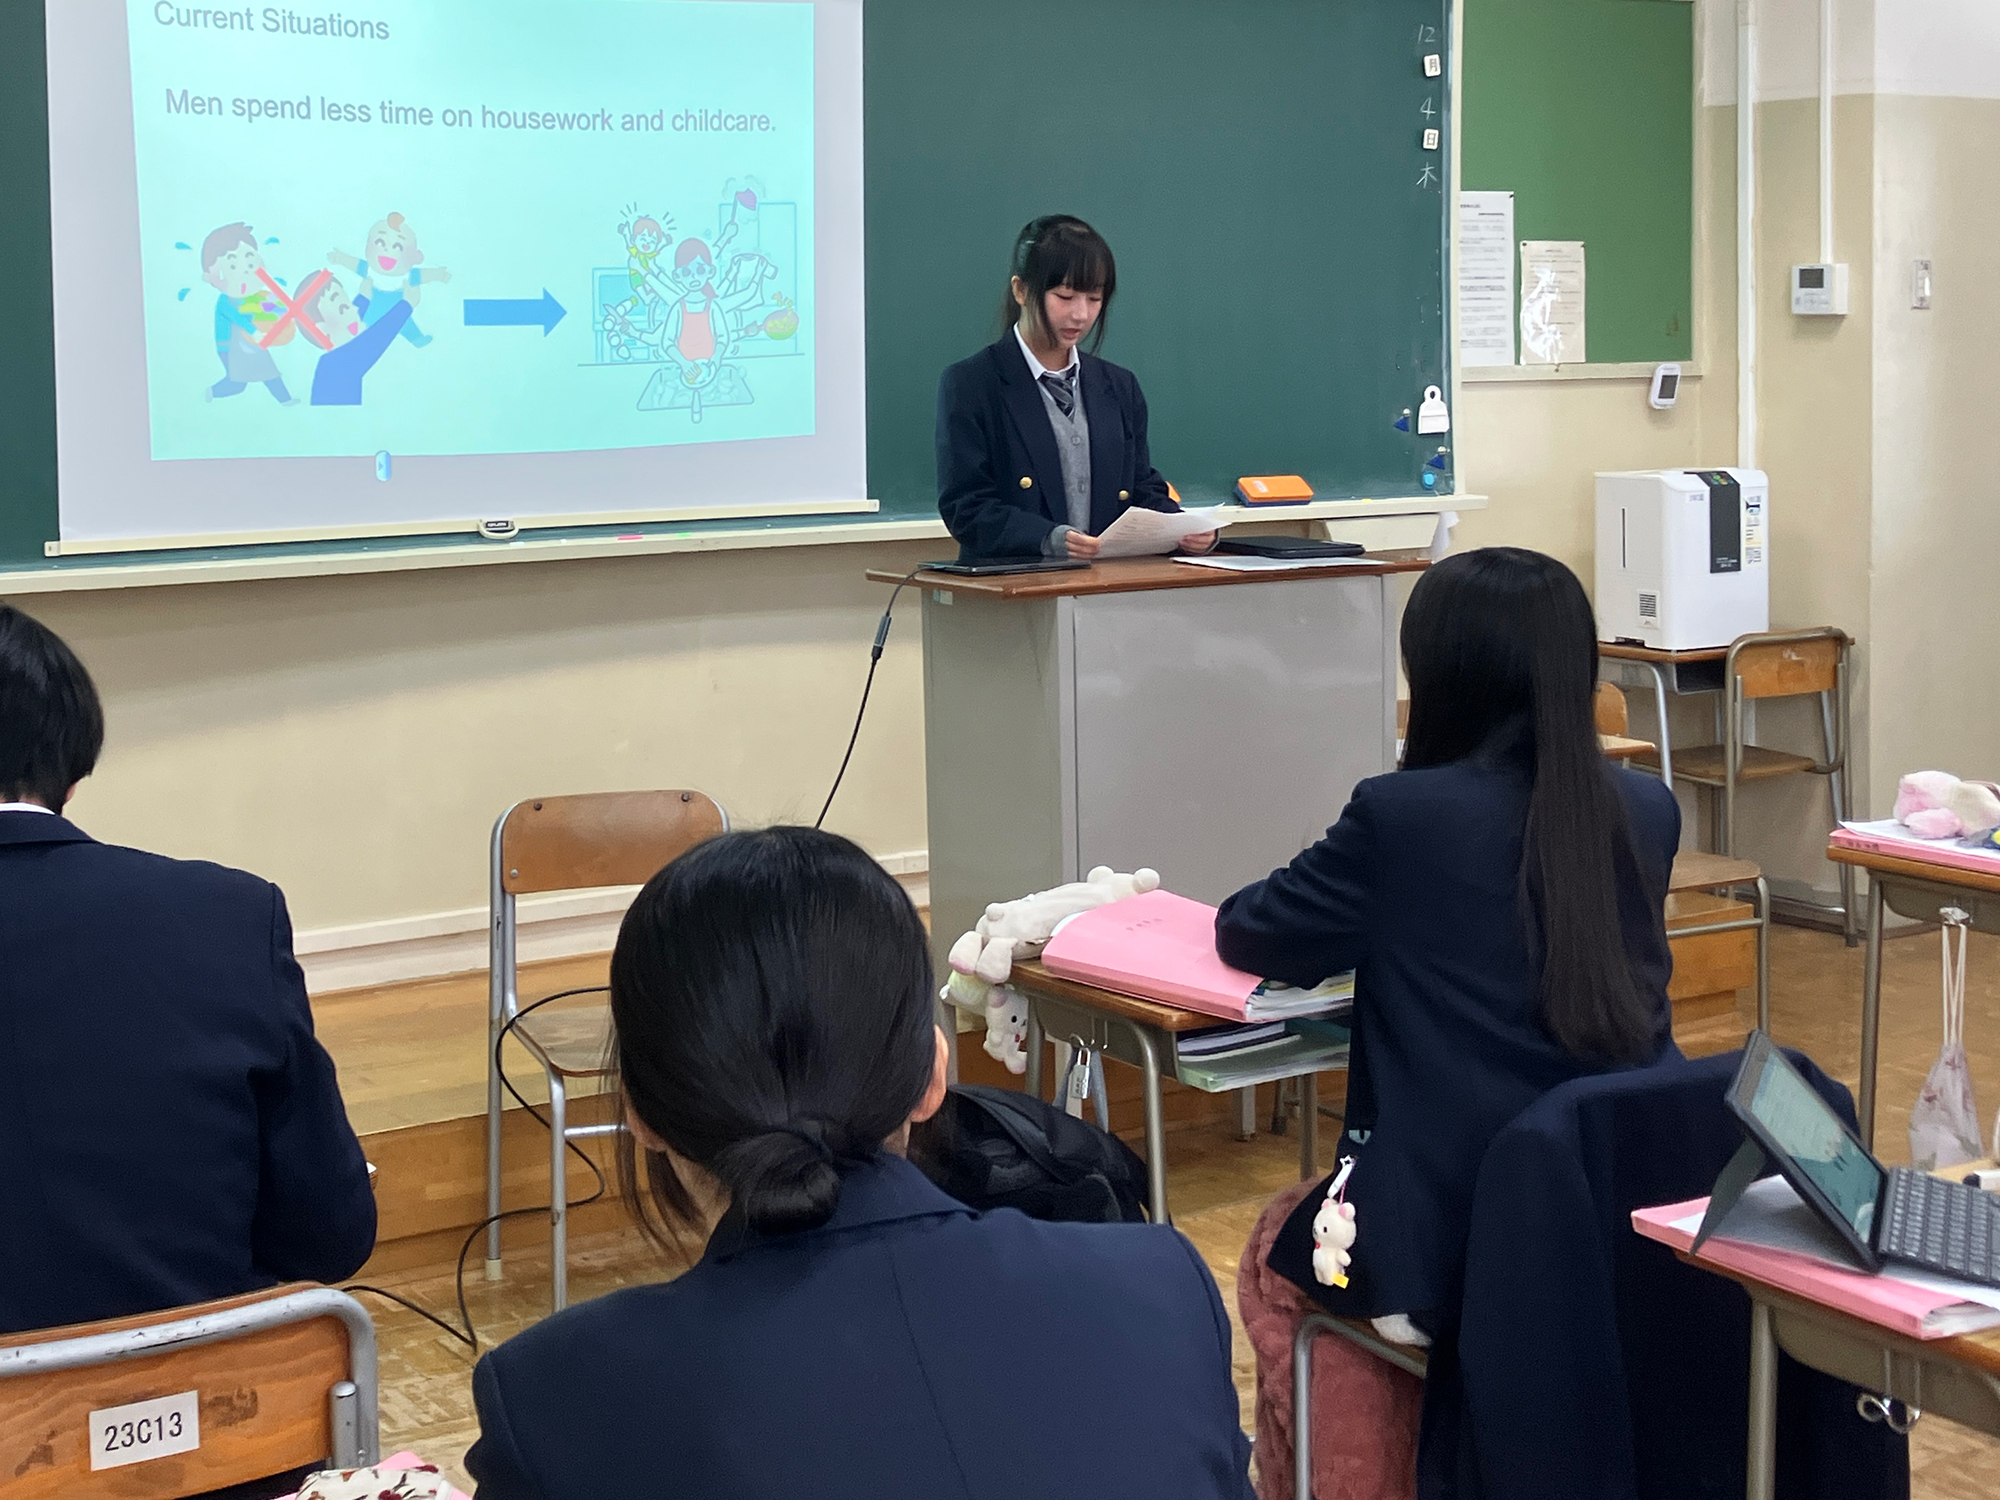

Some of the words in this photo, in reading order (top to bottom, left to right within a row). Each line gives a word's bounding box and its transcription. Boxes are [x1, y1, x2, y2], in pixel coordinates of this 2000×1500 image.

[154, 1, 254, 31] Current
[262, 8, 390, 39] Situations
[1418, 24, 1435, 43] 12
[166, 88, 223, 115] Men
[232, 95, 311, 123] spend
[320, 97, 371, 122] less
[379, 100, 433, 125] time
[442, 108, 472, 128] on
[482, 105, 614, 130] housework
[621, 109, 663, 131] and
[671, 109, 776, 132] childcare.
[1420, 97, 1436, 120] 4
[1416, 162, 1438, 188] 木
[105, 1412, 182, 1451] 23C13
